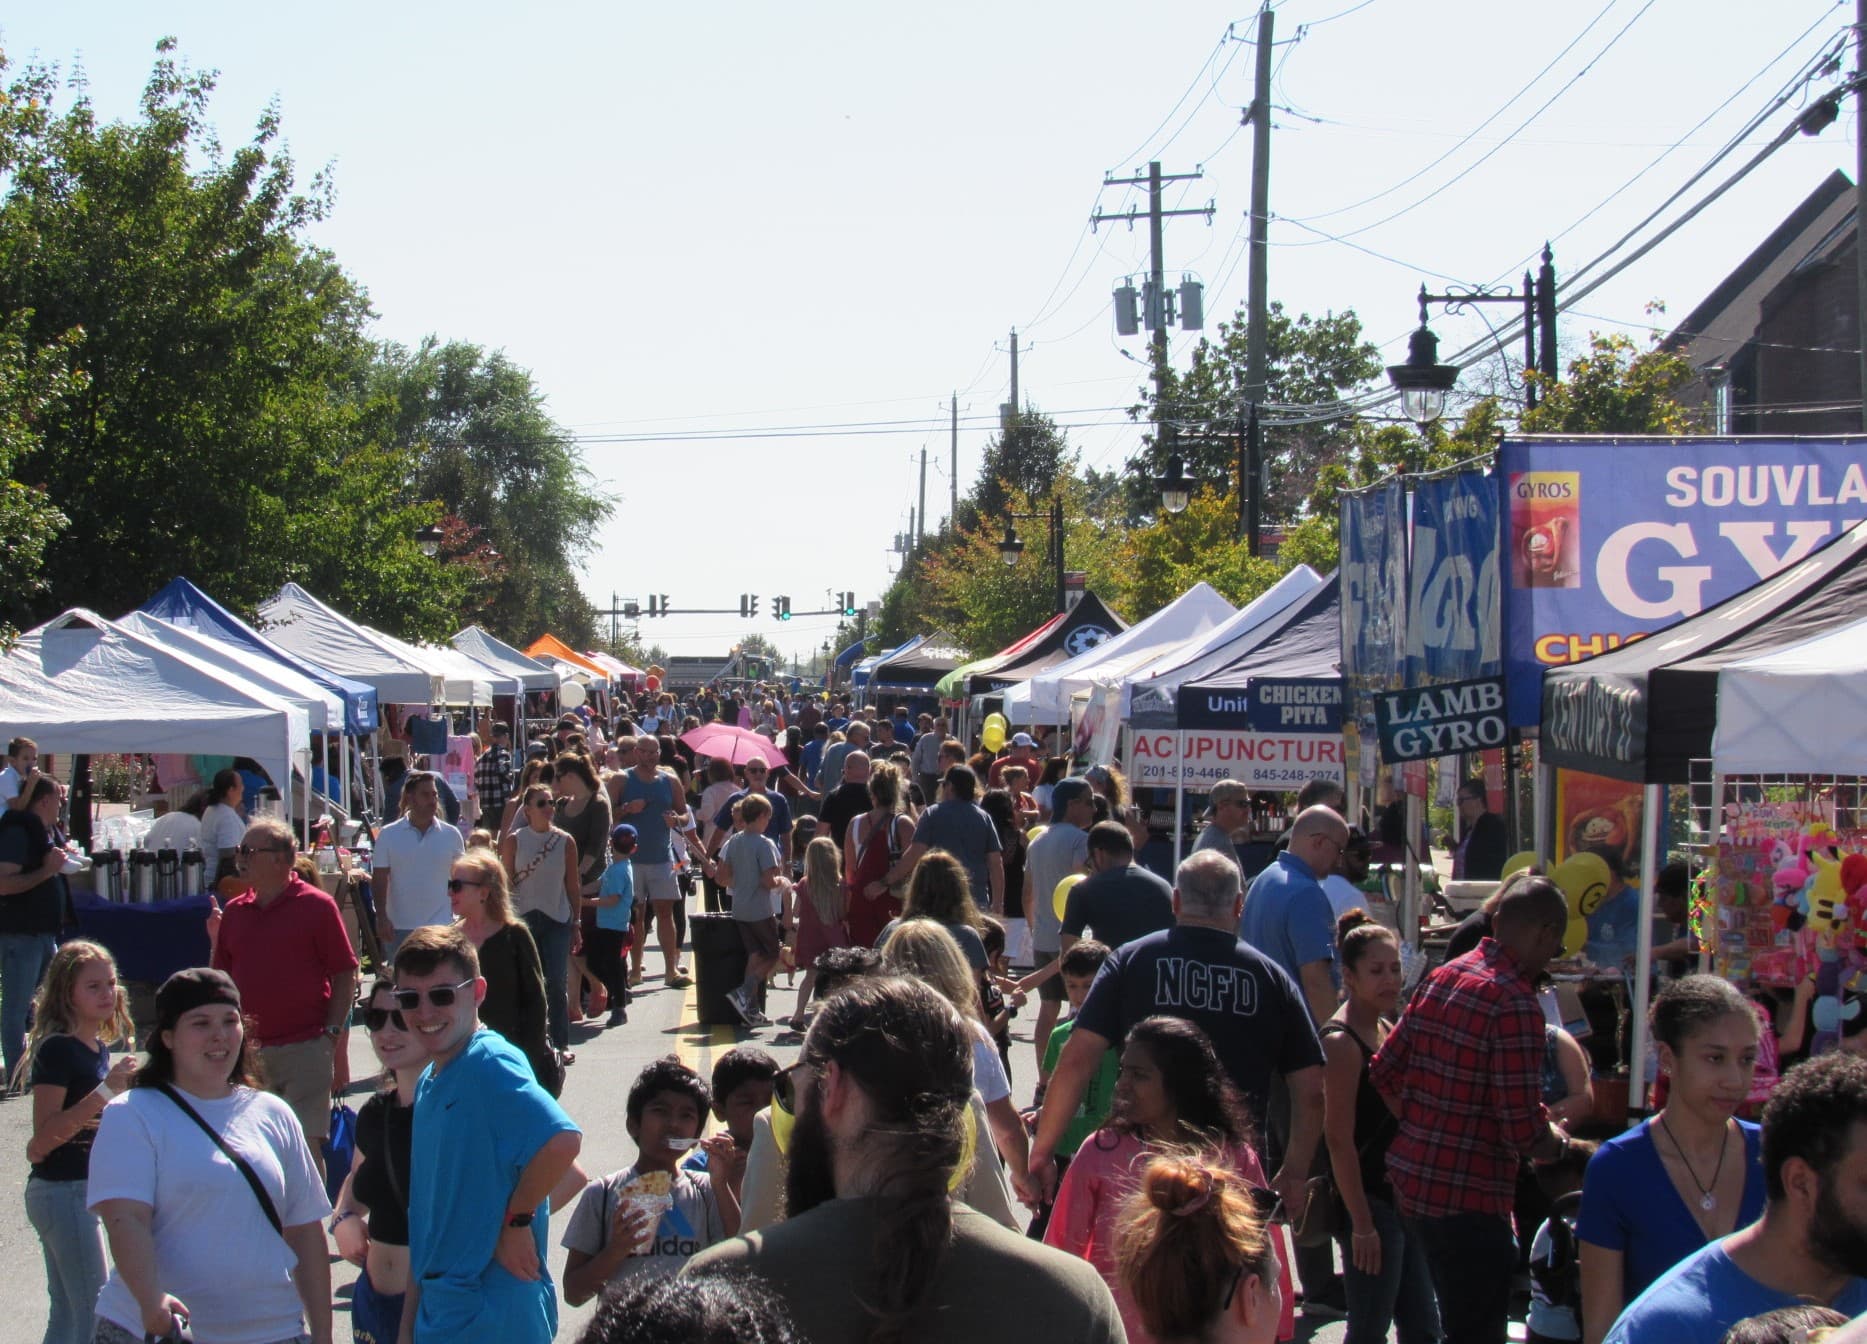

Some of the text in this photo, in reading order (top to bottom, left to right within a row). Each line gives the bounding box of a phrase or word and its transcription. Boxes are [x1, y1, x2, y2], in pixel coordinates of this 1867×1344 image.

[1516, 481, 1571, 499] GYROS
[1666, 463, 1867, 508] SOUVLA
[1596, 519, 1867, 620] GY
[1534, 632, 1652, 665] CHI
[1260, 685, 1342, 705] CHICKEN
[1280, 706, 1328, 725] PITA
[1385, 682, 1502, 725] LAMB
[1393, 716, 1505, 758] GYRO
[1551, 682, 1621, 758] CENTURY
[1155, 957, 1257, 1016] NCFD
